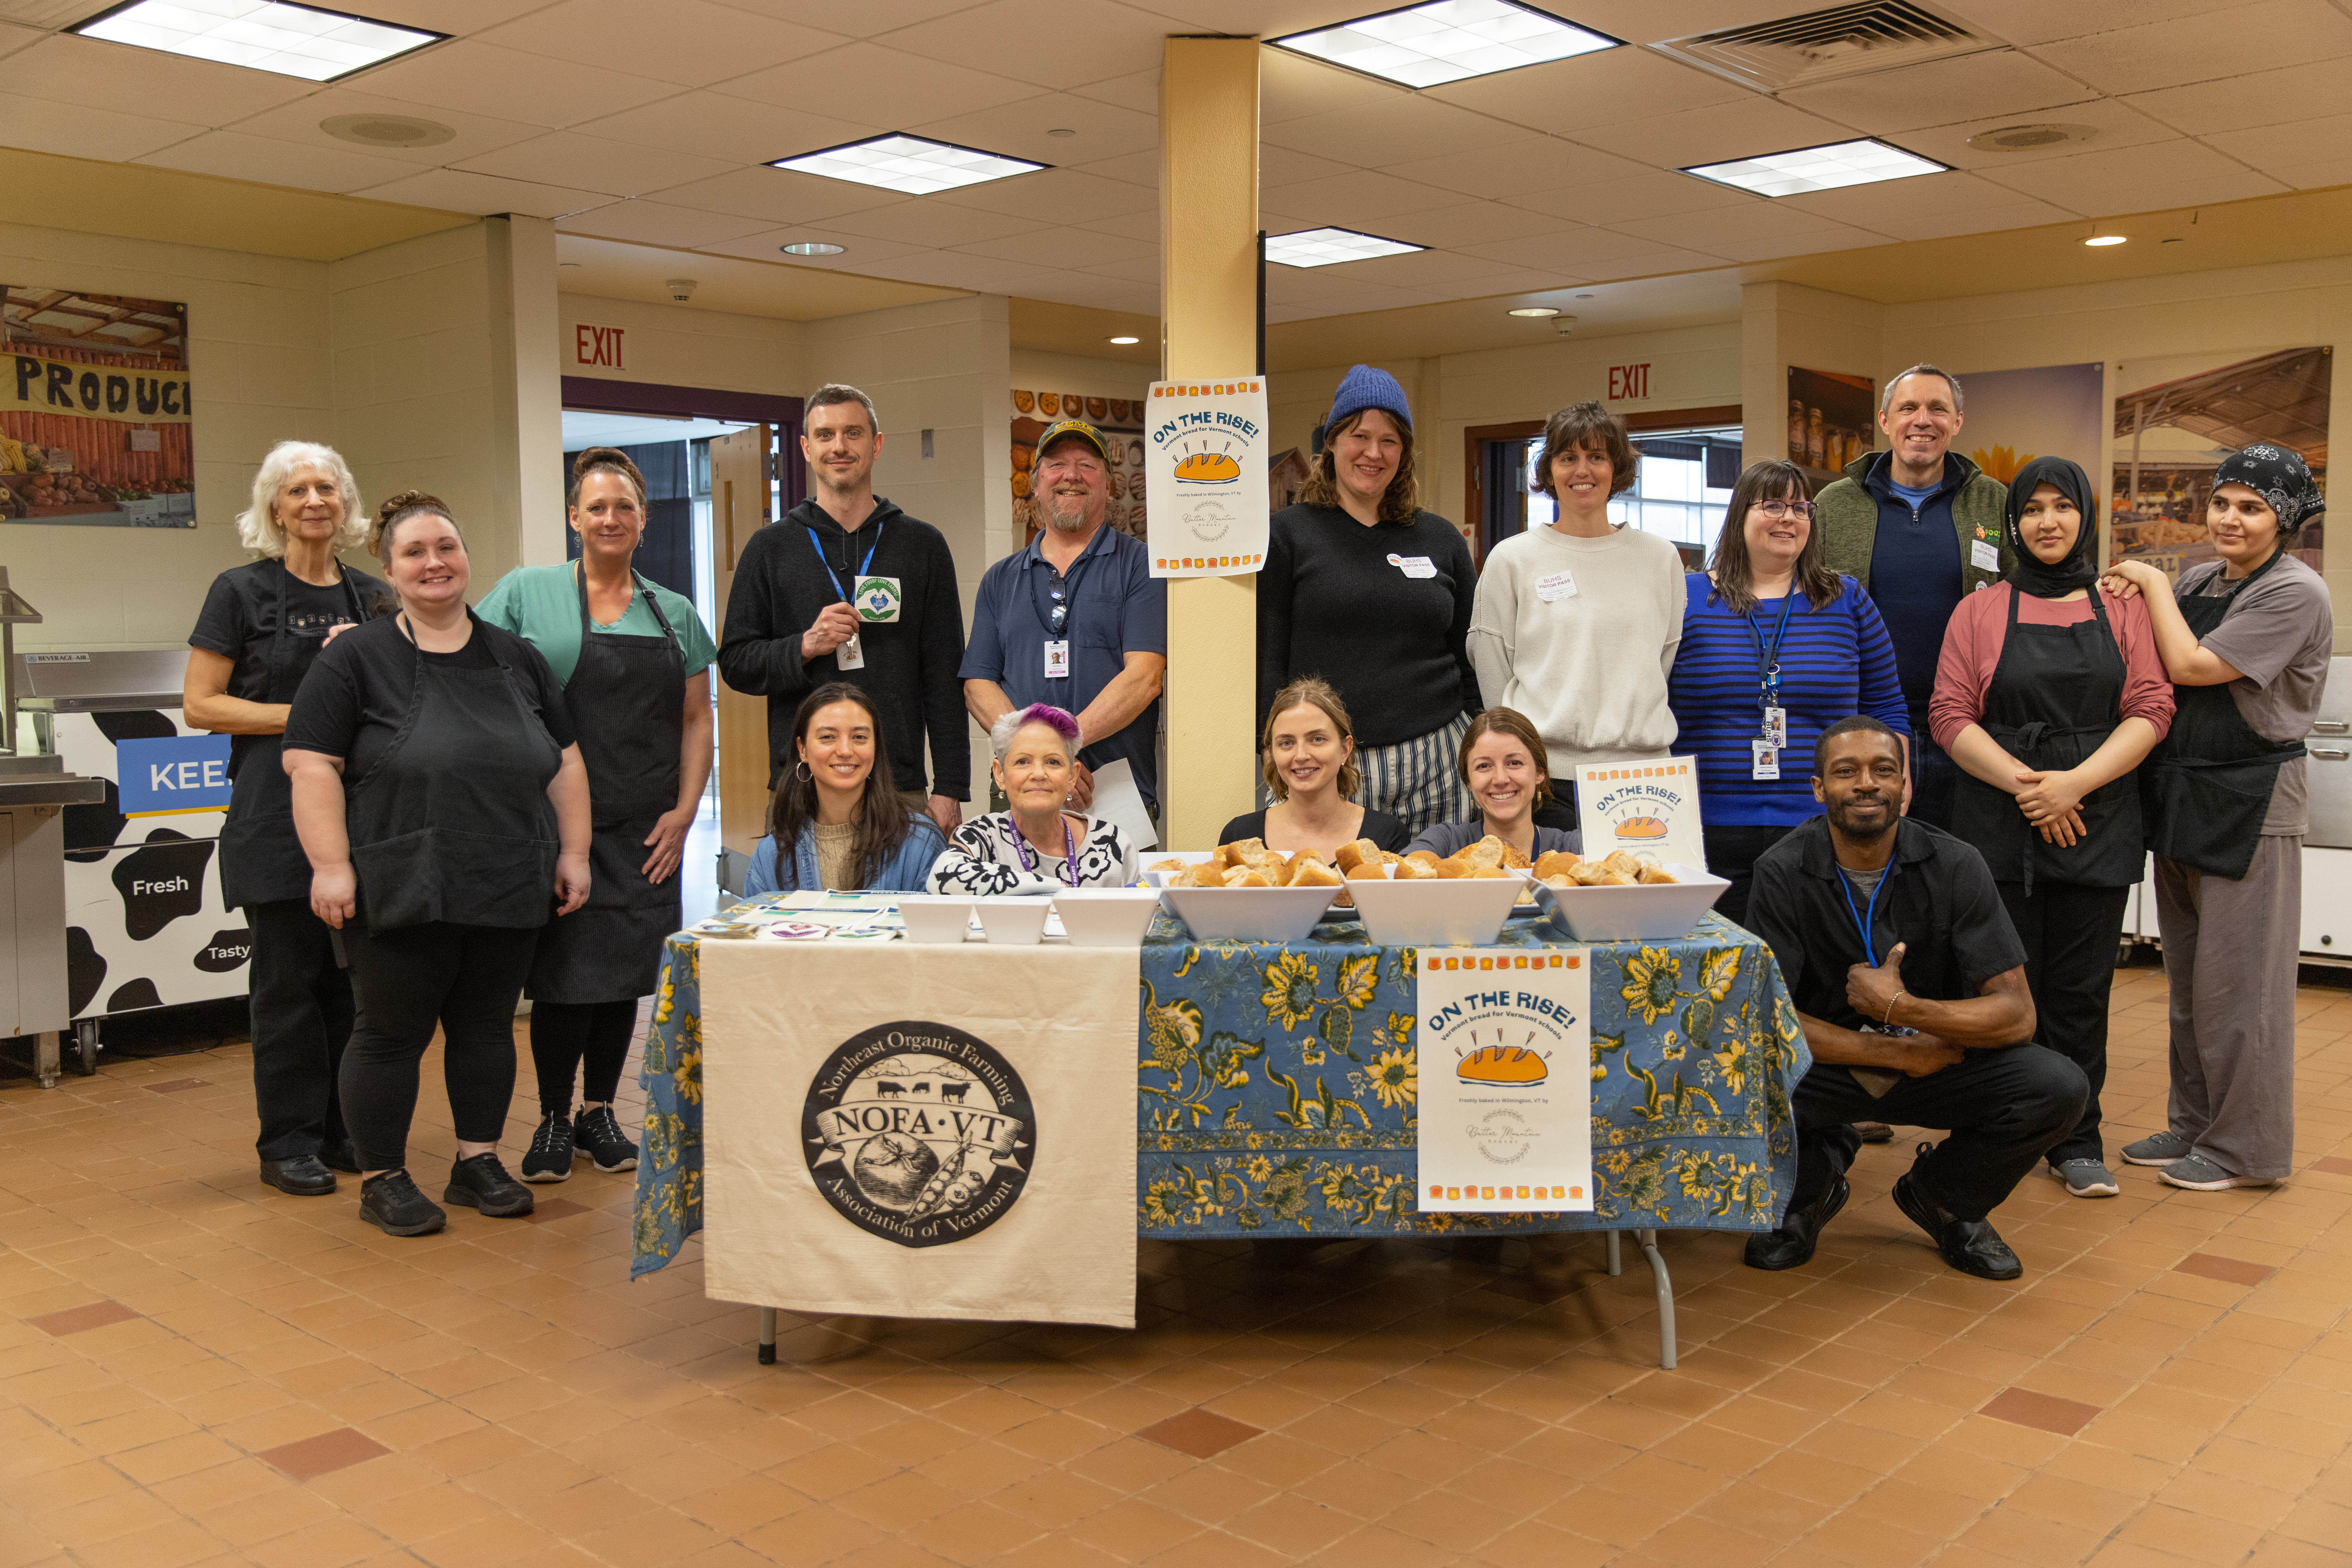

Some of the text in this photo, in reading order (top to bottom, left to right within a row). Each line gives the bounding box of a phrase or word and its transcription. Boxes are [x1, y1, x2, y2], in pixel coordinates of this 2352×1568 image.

[577, 325, 624, 367] EXIT
[1609, 364, 1651, 400] EXIT
[1153, 412, 1259, 443] ON THE RISE!
[1162, 433, 1182, 451] Vermont
[1182, 427, 1198, 436] bread
[1209, 426, 1232, 435] Vermont
[1233, 433, 1249, 447] schools
[1182, 513, 1236, 523] Butter Mountain
[1980, 544, 1992, 553] BUHS
[858, 584, 867, 595] LOVE
[865, 578, 877, 586] FOOD?
[887, 582, 899, 596] FARMS!
[150, 760, 233, 791] KEE
[1597, 785, 1681, 810] ON THE RISE!
[1604, 802, 1619, 816] Vermont
[1659, 801, 1674, 812] schools
[1012, 830, 1027, 862] BUHS BEARS
[133, 876, 189, 896] Fresh
[208, 945, 251, 959] Tasty
[1429, 991, 1576, 1031] ON THE RISE!
[1441, 1019, 1468, 1041] Vermont
[1469, 1011, 1491, 1021] bread
[1506, 1011, 1537, 1023] Vermont
[1539, 1020, 1562, 1040] schools
[819, 1031, 1015, 1106] Northeast Organic Farming
[1465, 1124, 1541, 1138] Butter Mountain
[827, 1178, 1014, 1237] Association of Vermont
